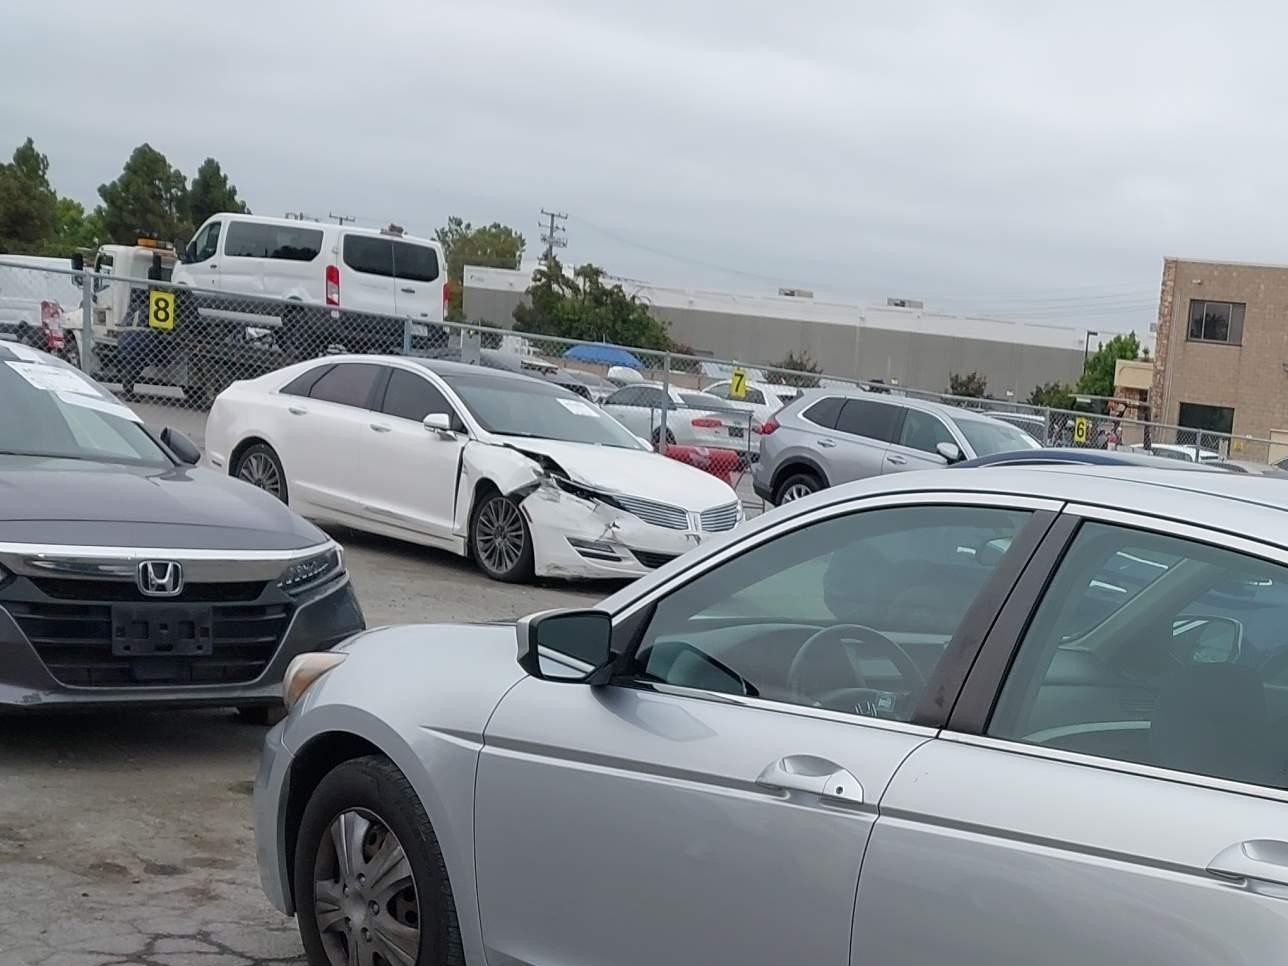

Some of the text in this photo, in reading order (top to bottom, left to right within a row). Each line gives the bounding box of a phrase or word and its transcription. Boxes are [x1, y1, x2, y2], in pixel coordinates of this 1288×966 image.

[153, 297, 170, 323] 8
[734, 372, 744, 392] 7
[1076, 421, 1084, 438] 6
